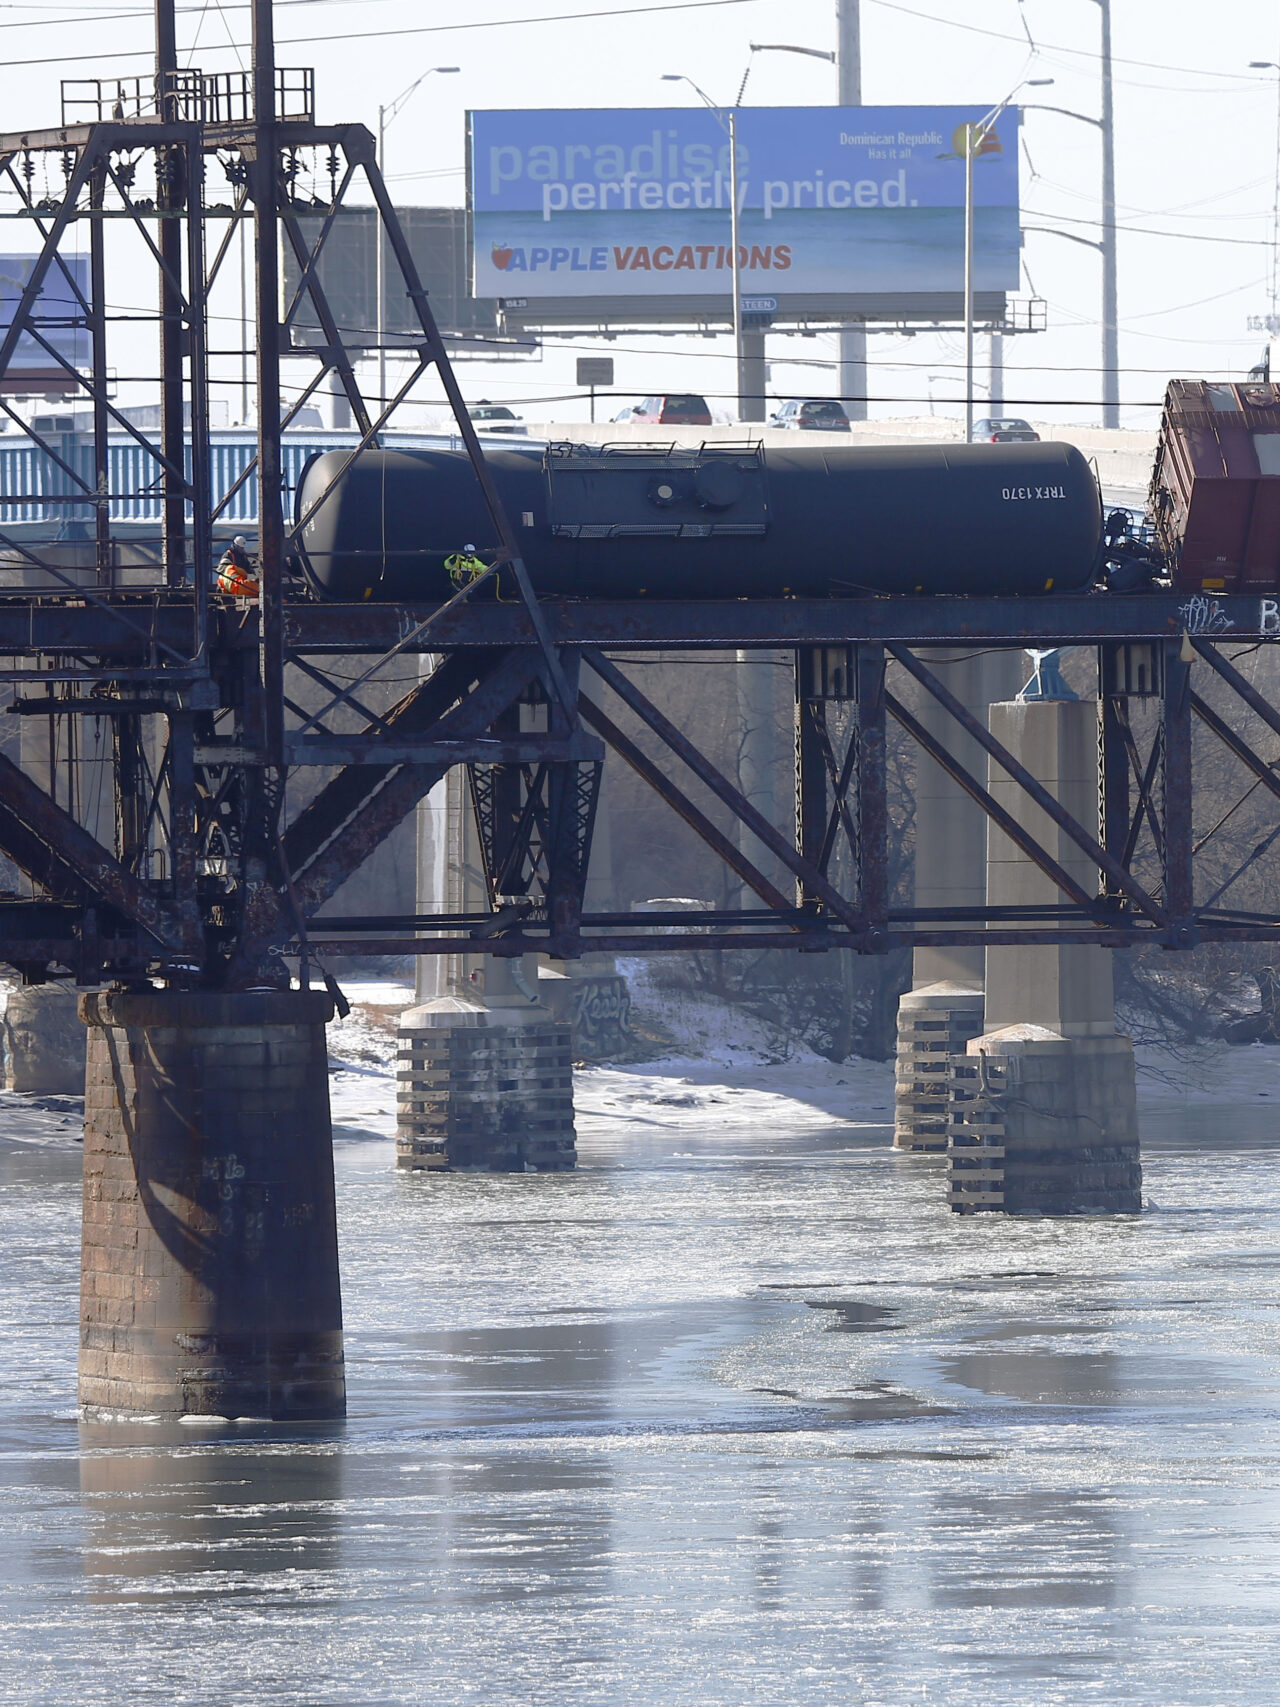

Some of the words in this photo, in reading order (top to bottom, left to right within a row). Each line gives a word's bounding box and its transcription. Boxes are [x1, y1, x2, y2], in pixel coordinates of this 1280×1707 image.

[840, 131, 895, 145] Dominican
[898, 131, 943, 147] Republic
[868, 148, 887, 159] Has
[889, 148, 897, 159] it
[490, 130, 749, 195] paradise
[543, 170, 748, 221] perfectly
[764, 169, 918, 219] priced.
[505, 246, 609, 272] APPLE
[613, 244, 793, 270] VACATIONS
[1002, 487, 1032, 500] 1370
[1034, 486, 1066, 499] TRFX
